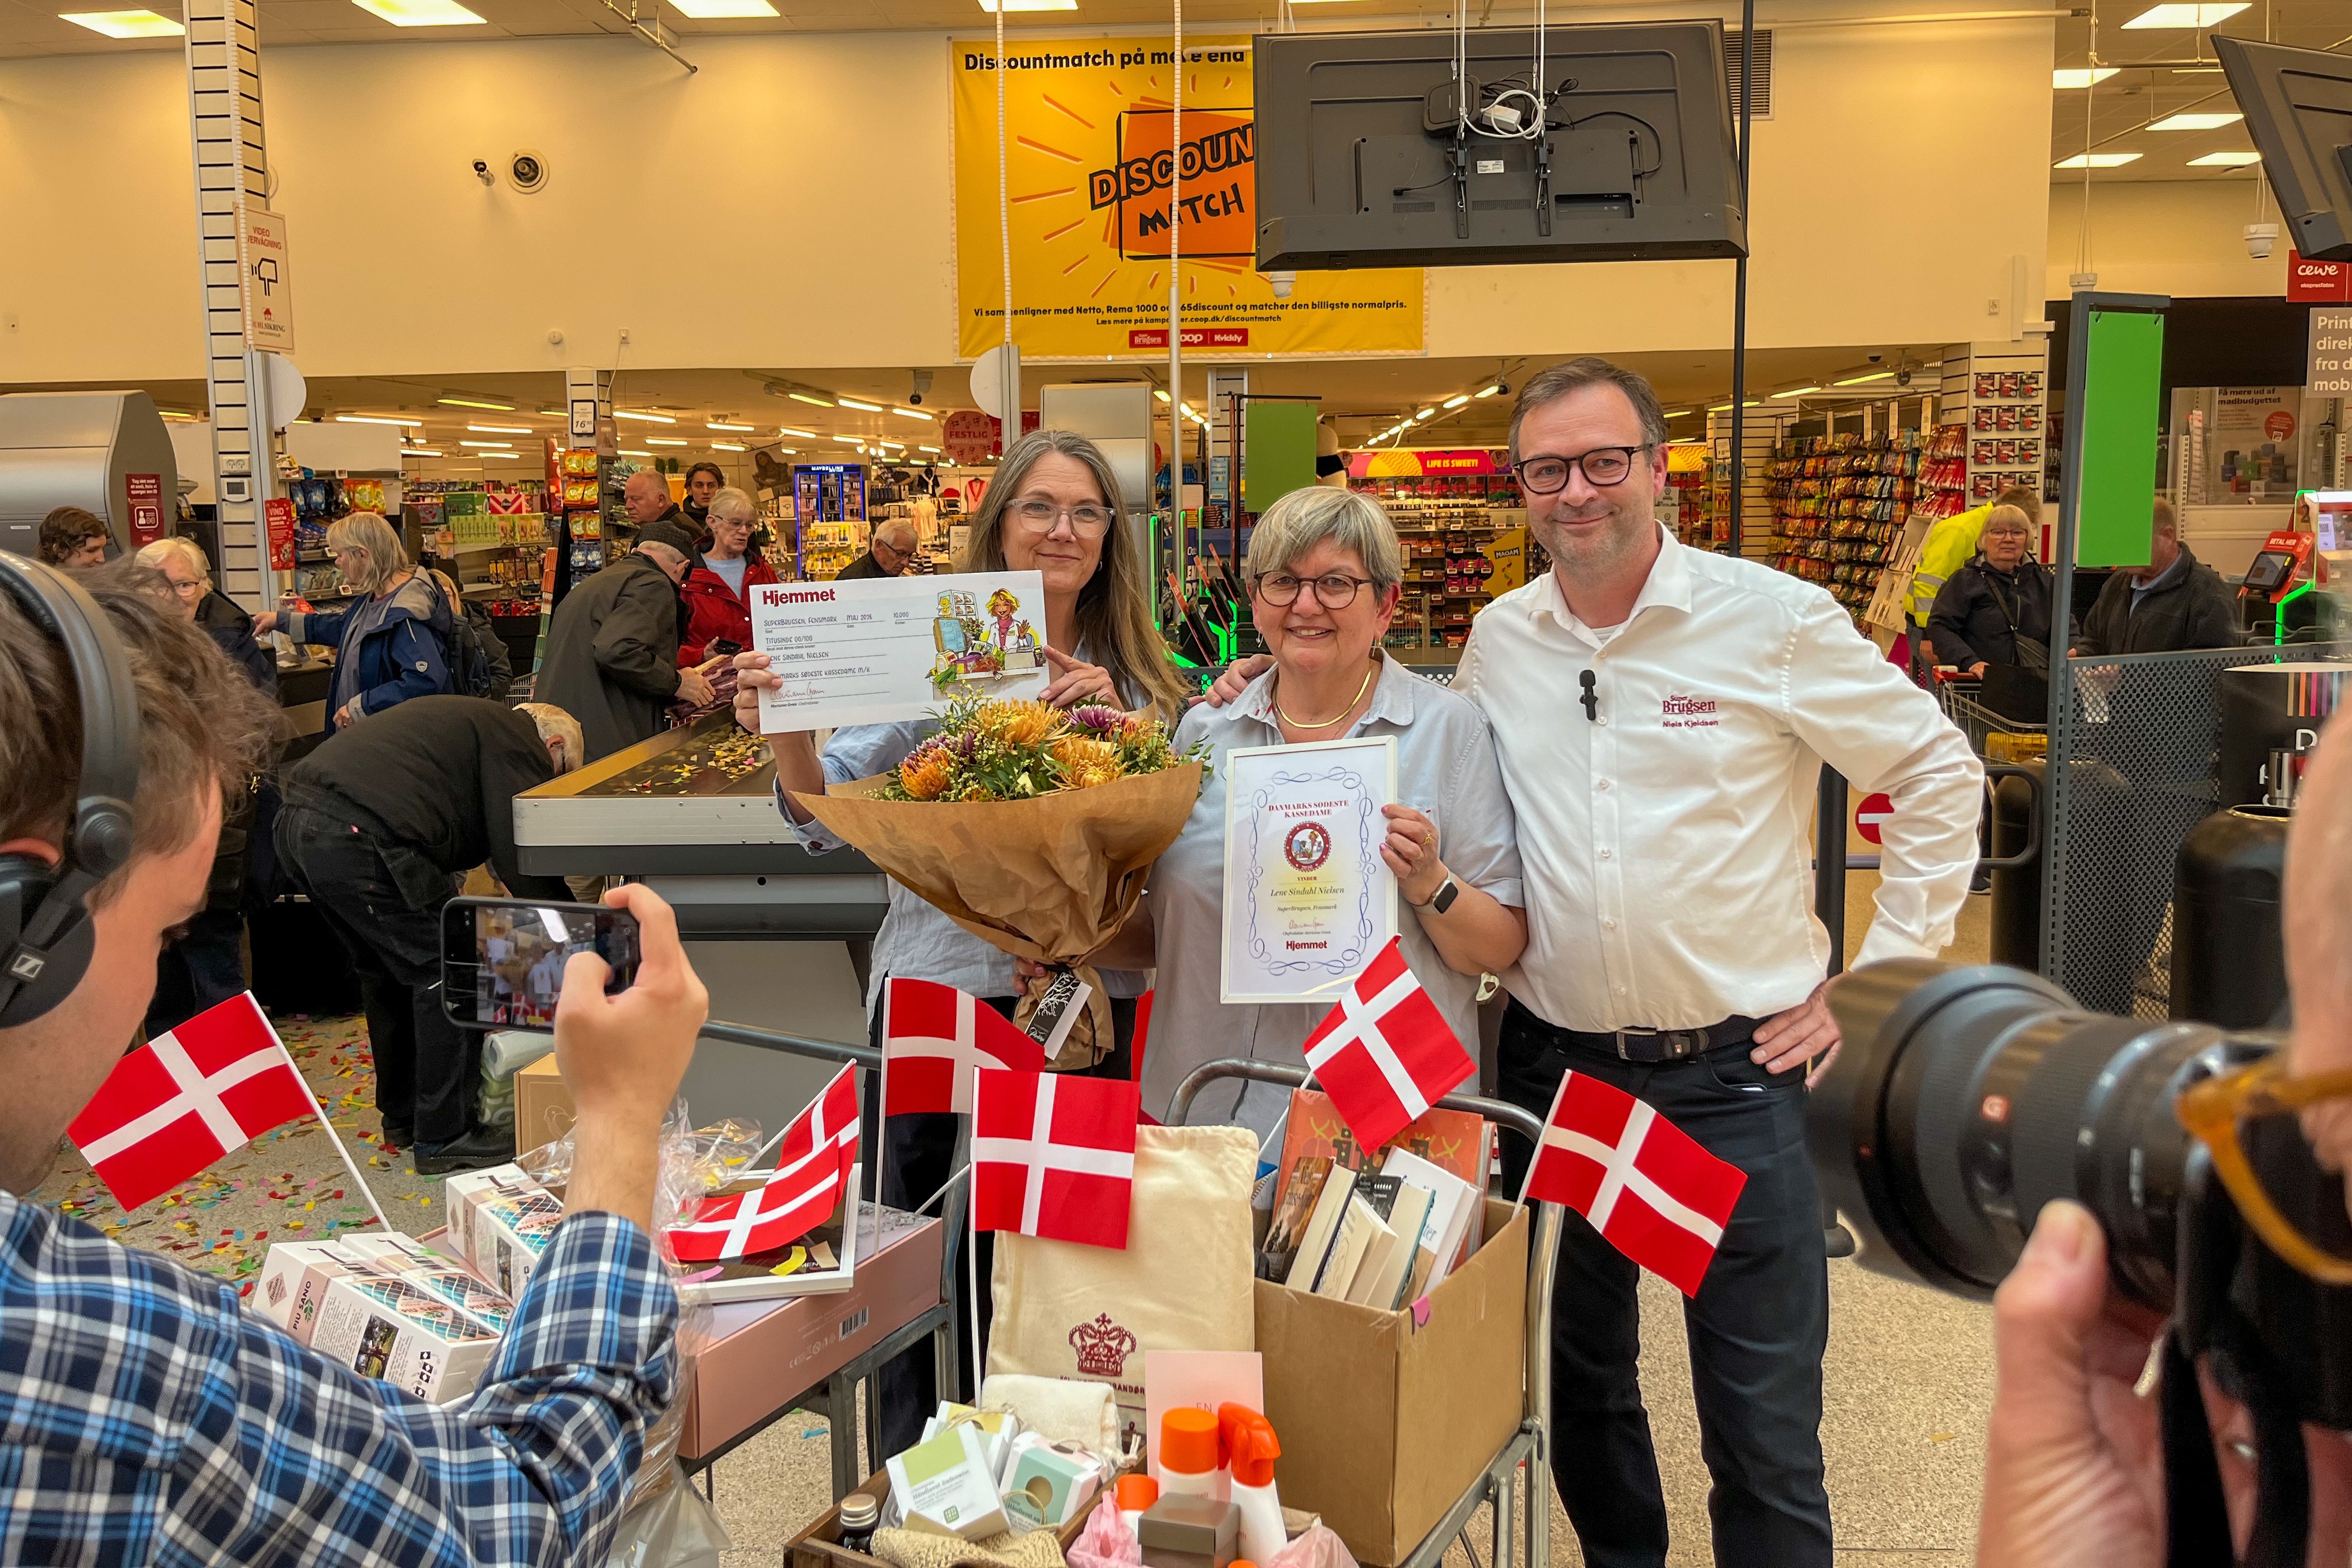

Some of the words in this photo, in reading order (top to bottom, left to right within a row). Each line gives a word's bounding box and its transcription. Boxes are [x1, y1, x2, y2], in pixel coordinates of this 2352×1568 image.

[1121, 48, 1144, 69] på
[1151, 51, 1202, 65] mee
[1089, 123, 1254, 211] DISCOUN
[253, 226, 270, 237] VIDEO
[247, 235, 282, 250] ERVÅGNING
[2297, 264, 2339, 276] cewe
[974, 308, 983, 316] Vi
[985, 307, 1052, 317] samenligner
[1054, 306, 1069, 315] med
[1077, 306, 1104, 316] Netto,
[1107, 305, 1132, 313] Rema
[1137, 304, 1157, 313] 1000
[1180, 302, 1233, 311] 65discount
[1236, 304, 1247, 312] og
[1250, 302, 1289, 310] matcher
[1292, 302, 1309, 310] den
[1311, 301, 1349, 311] billigste
[1352, 300, 1407, 310] normalpris.
[1134, 317, 1143, 326] på
[1145, 316, 1282, 326] kamper.coop.dk/discountmatch
[1134, 335, 1161, 344] Brugsen
[1180, 334, 1203, 343] oop
[1214, 334, 1242, 342] Kvickly
[2315, 357, 2339, 370] fra
[1426, 459, 1442, 468] LIFE
[1443, 459, 1450, 467] IS
[1451, 459, 1478, 467] SWEET!
[269, 508, 284, 516] VIND
[1496, 547, 1520, 558] MAOAM
[762, 587, 836, 607] Hjemmet
[765, 636, 793, 645] TITUSINDE
[1662, 699, 1716, 715] Brugsen
[1684, 720, 1718, 728] Kjeldsen
[1268, 802, 1312, 812] DANMARKS
[1284, 808, 1332, 818] KASSEDAME
[1288, 887, 1317, 896] Sindahl
[1317, 886, 1345, 894] Nielsen
[1286, 940, 1328, 951] Hjemmet
[538, 1217, 561, 1226] SAN
[1423, 1224, 1437, 1241] ter
[270, 1278, 279, 1300] Italian
[293, 1312, 302, 1330] PIU
[298, 1280, 312, 1310] SANO
